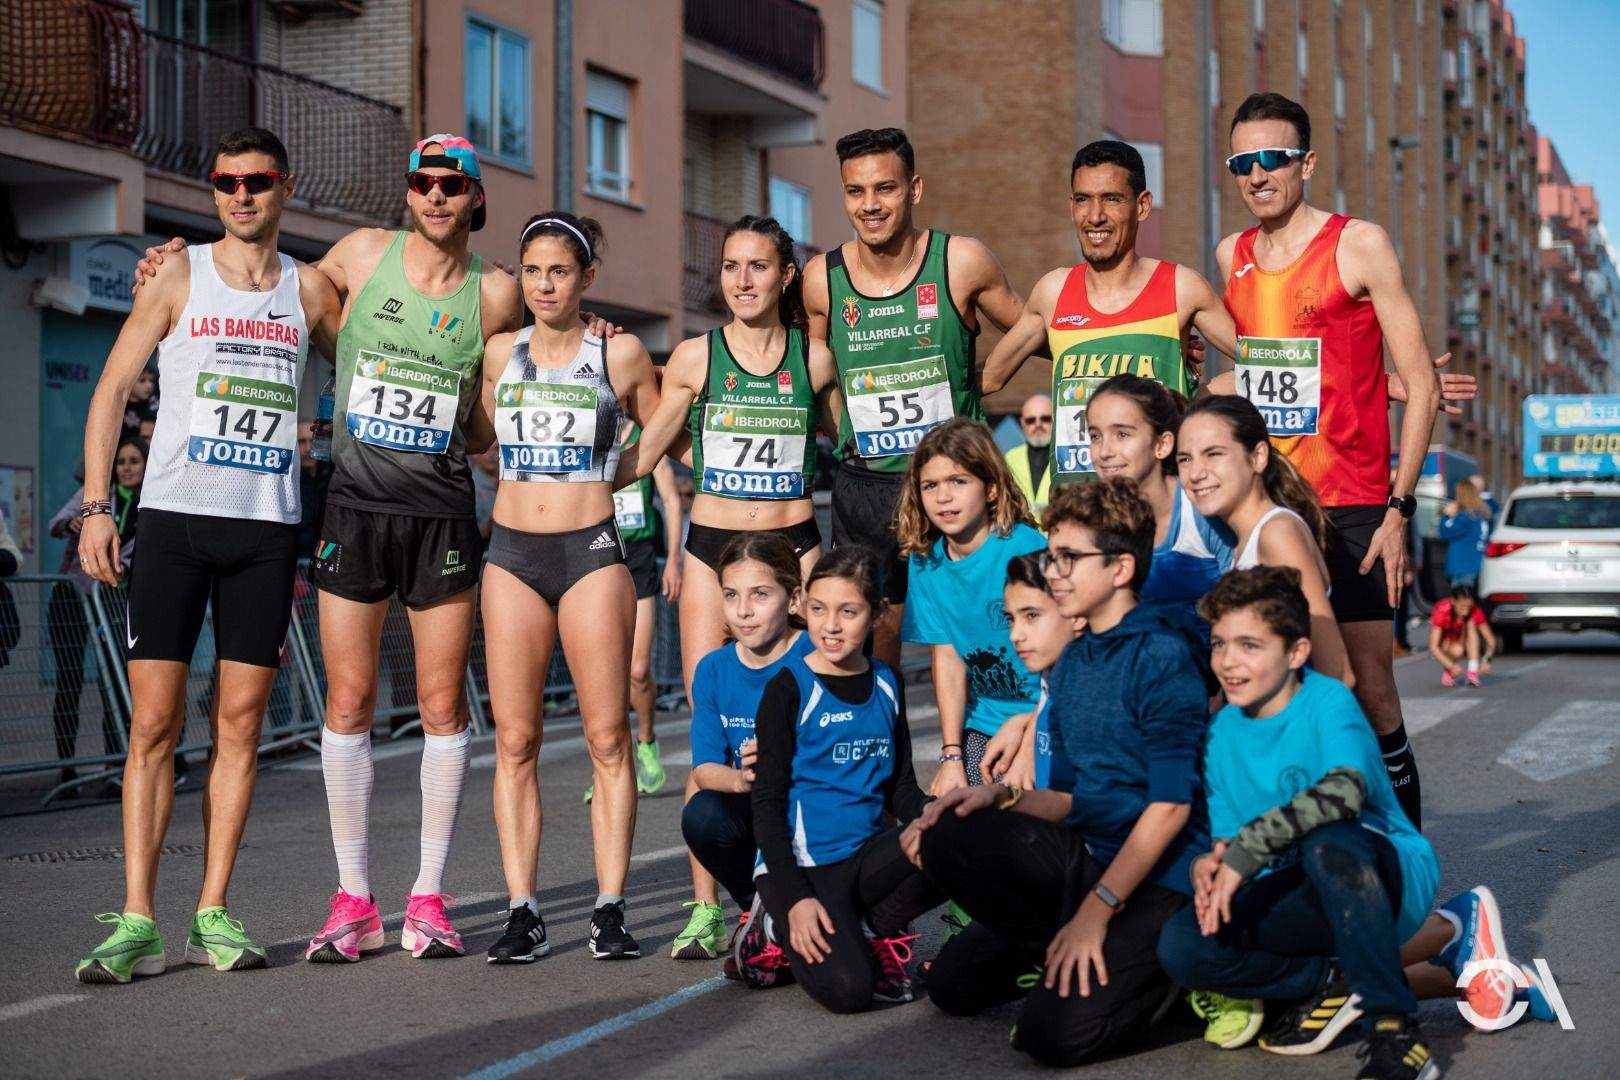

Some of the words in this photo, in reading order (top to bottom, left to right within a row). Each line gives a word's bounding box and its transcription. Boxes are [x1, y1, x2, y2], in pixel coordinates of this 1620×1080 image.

[373, 312, 405, 325] INVERSE
[1055, 314, 1083, 324] saucony
[191, 317, 220, 338] LAS
[225, 318, 299, 347] BANDERAS
[847, 326, 912, 342] VILLARREAL
[216, 343, 261, 355] FACTORY
[263, 347, 297, 362] BRANDS
[383, 342, 399, 353] RUN
[400, 346, 420, 359] WITH
[1248, 348, 1312, 361] IBERDROLA
[1061, 354, 1156, 378] BIKILA
[387, 366, 452, 389] IBERDROLA
[573, 372, 600, 380] adidas
[875, 366, 941, 386] IBERDROLA
[230, 384, 293, 405] IBERDROLA
[523, 389, 591, 402] IBERDROLA
[1241, 369, 1299, 405] 148
[370, 385, 437, 425] 134
[722, 394, 778, 404] VILLARREAL
[878, 392, 924, 428] 55
[213, 404, 282, 443] 147
[510, 410, 576, 443] 182
[735, 416, 802, 429] IBERDROLA
[732, 437, 778, 469] 74
[589, 541, 616, 550] adidas
[831, 711, 854, 722] asics
